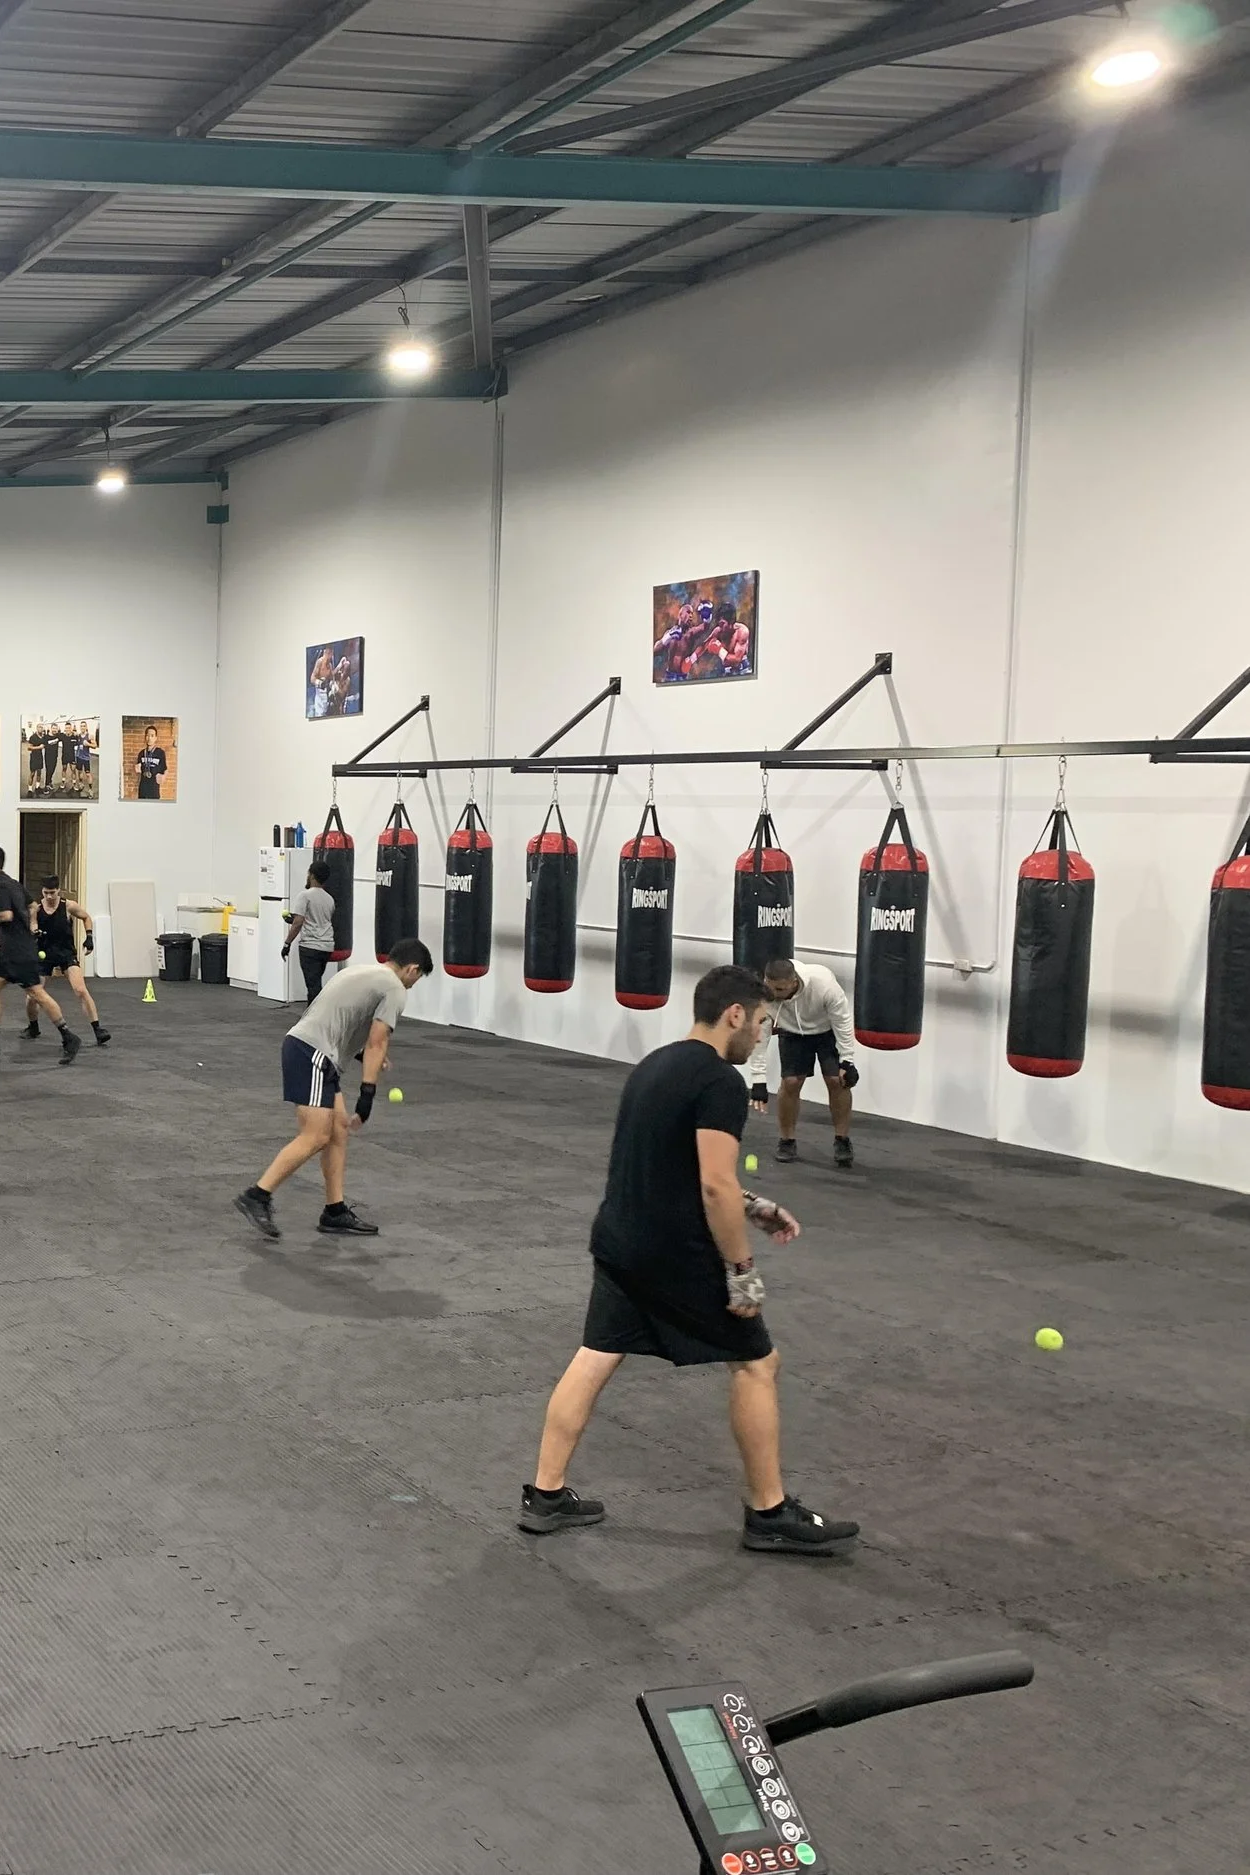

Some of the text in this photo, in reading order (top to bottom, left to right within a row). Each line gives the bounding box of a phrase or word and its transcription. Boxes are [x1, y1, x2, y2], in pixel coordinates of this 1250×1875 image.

[631, 887, 668, 909] RINGSPORT
[870, 906, 916, 933] RINGSPORT
[756, 1788, 770, 1812] Target
